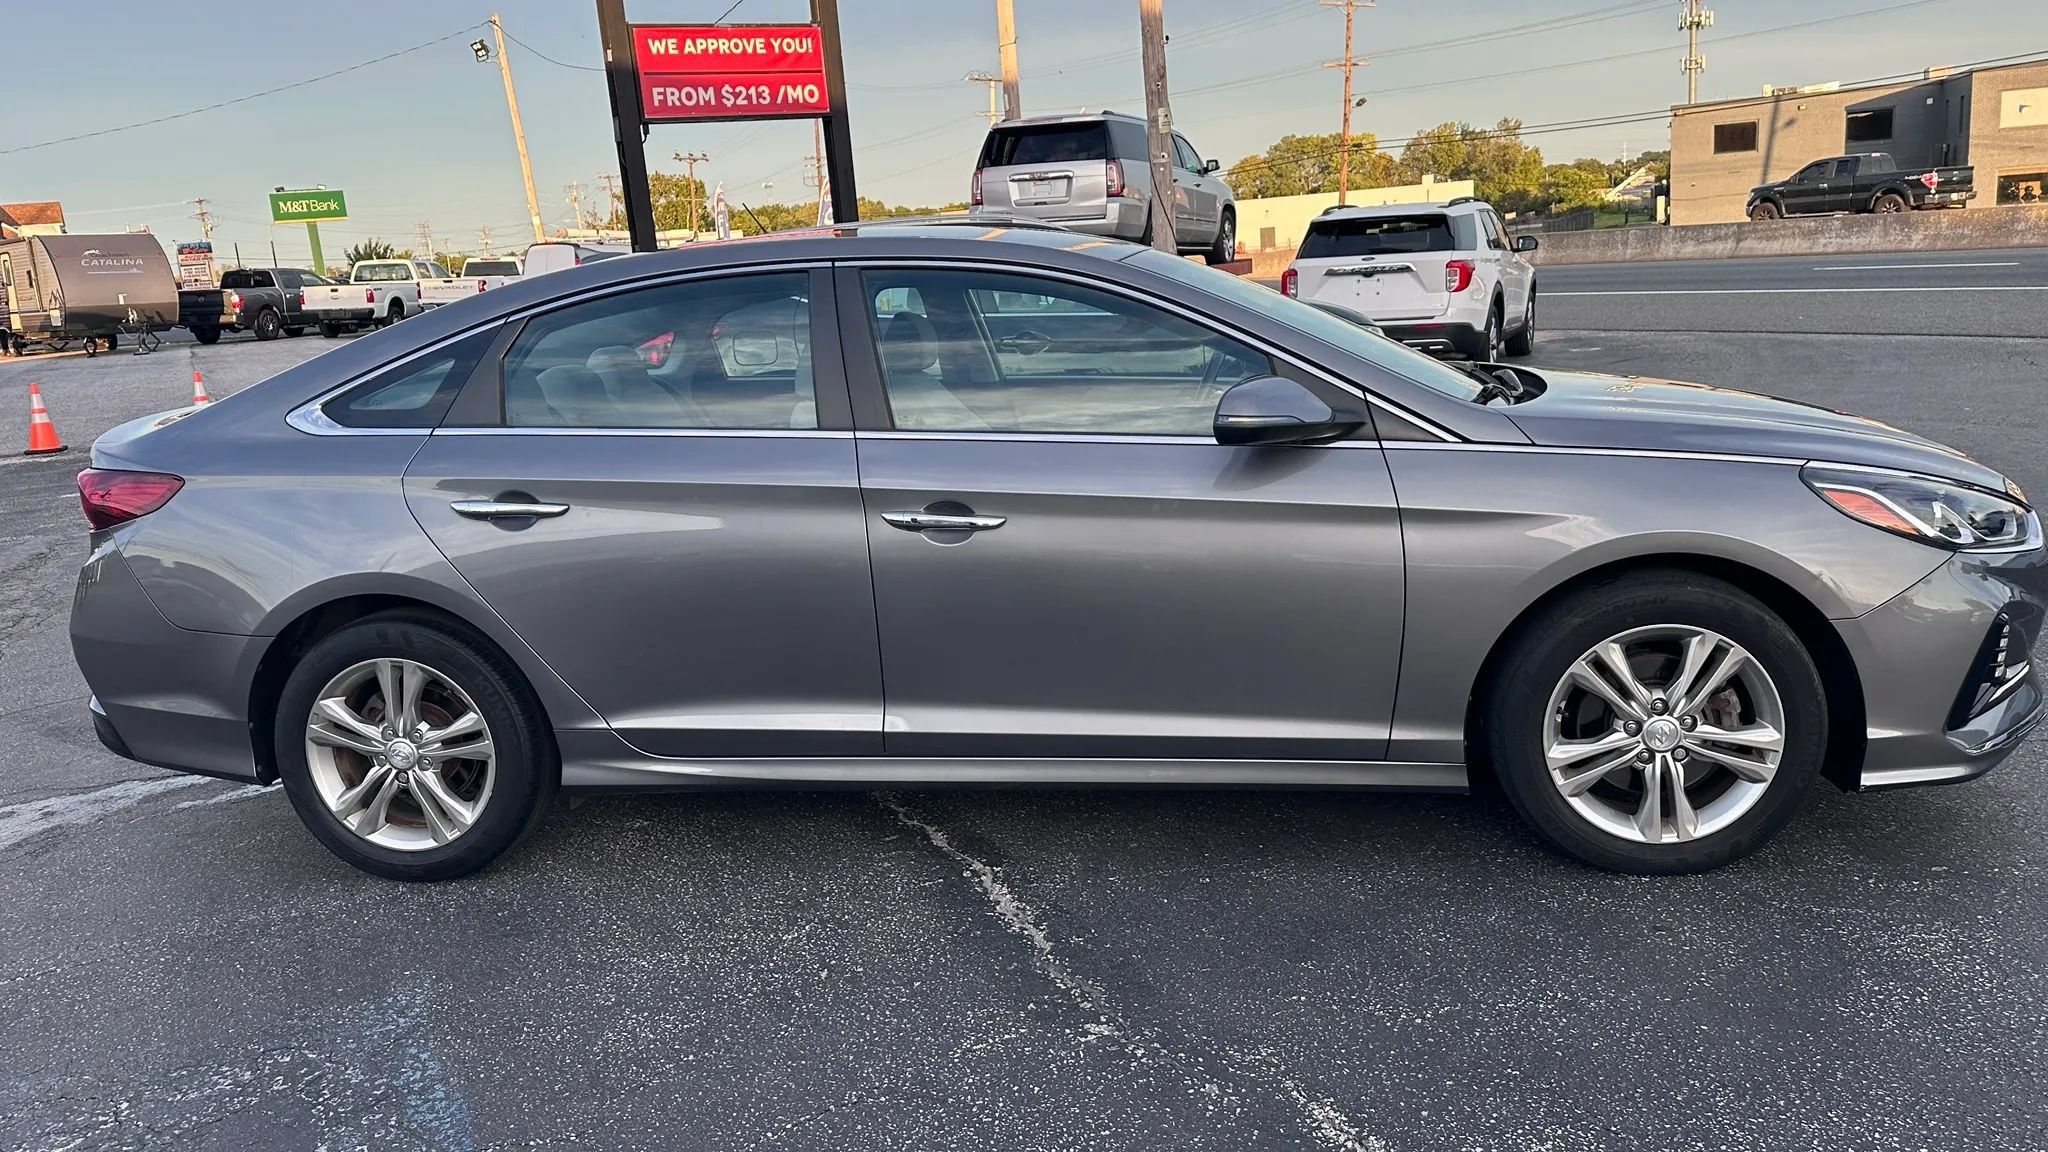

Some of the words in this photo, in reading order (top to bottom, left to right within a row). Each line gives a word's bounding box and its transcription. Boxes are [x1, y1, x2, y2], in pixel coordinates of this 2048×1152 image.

[647, 38, 680, 55] WE
[683, 37, 767, 55] APPROVE
[769, 37, 814, 54] YOU!
[651, 86, 717, 107] FROM
[721, 84, 771, 107] $213
[776, 84, 820, 105] /MO
[278, 199, 309, 213] M&T
[309, 198, 340, 212] Bank
[80, 258, 144, 266] CATALINA
